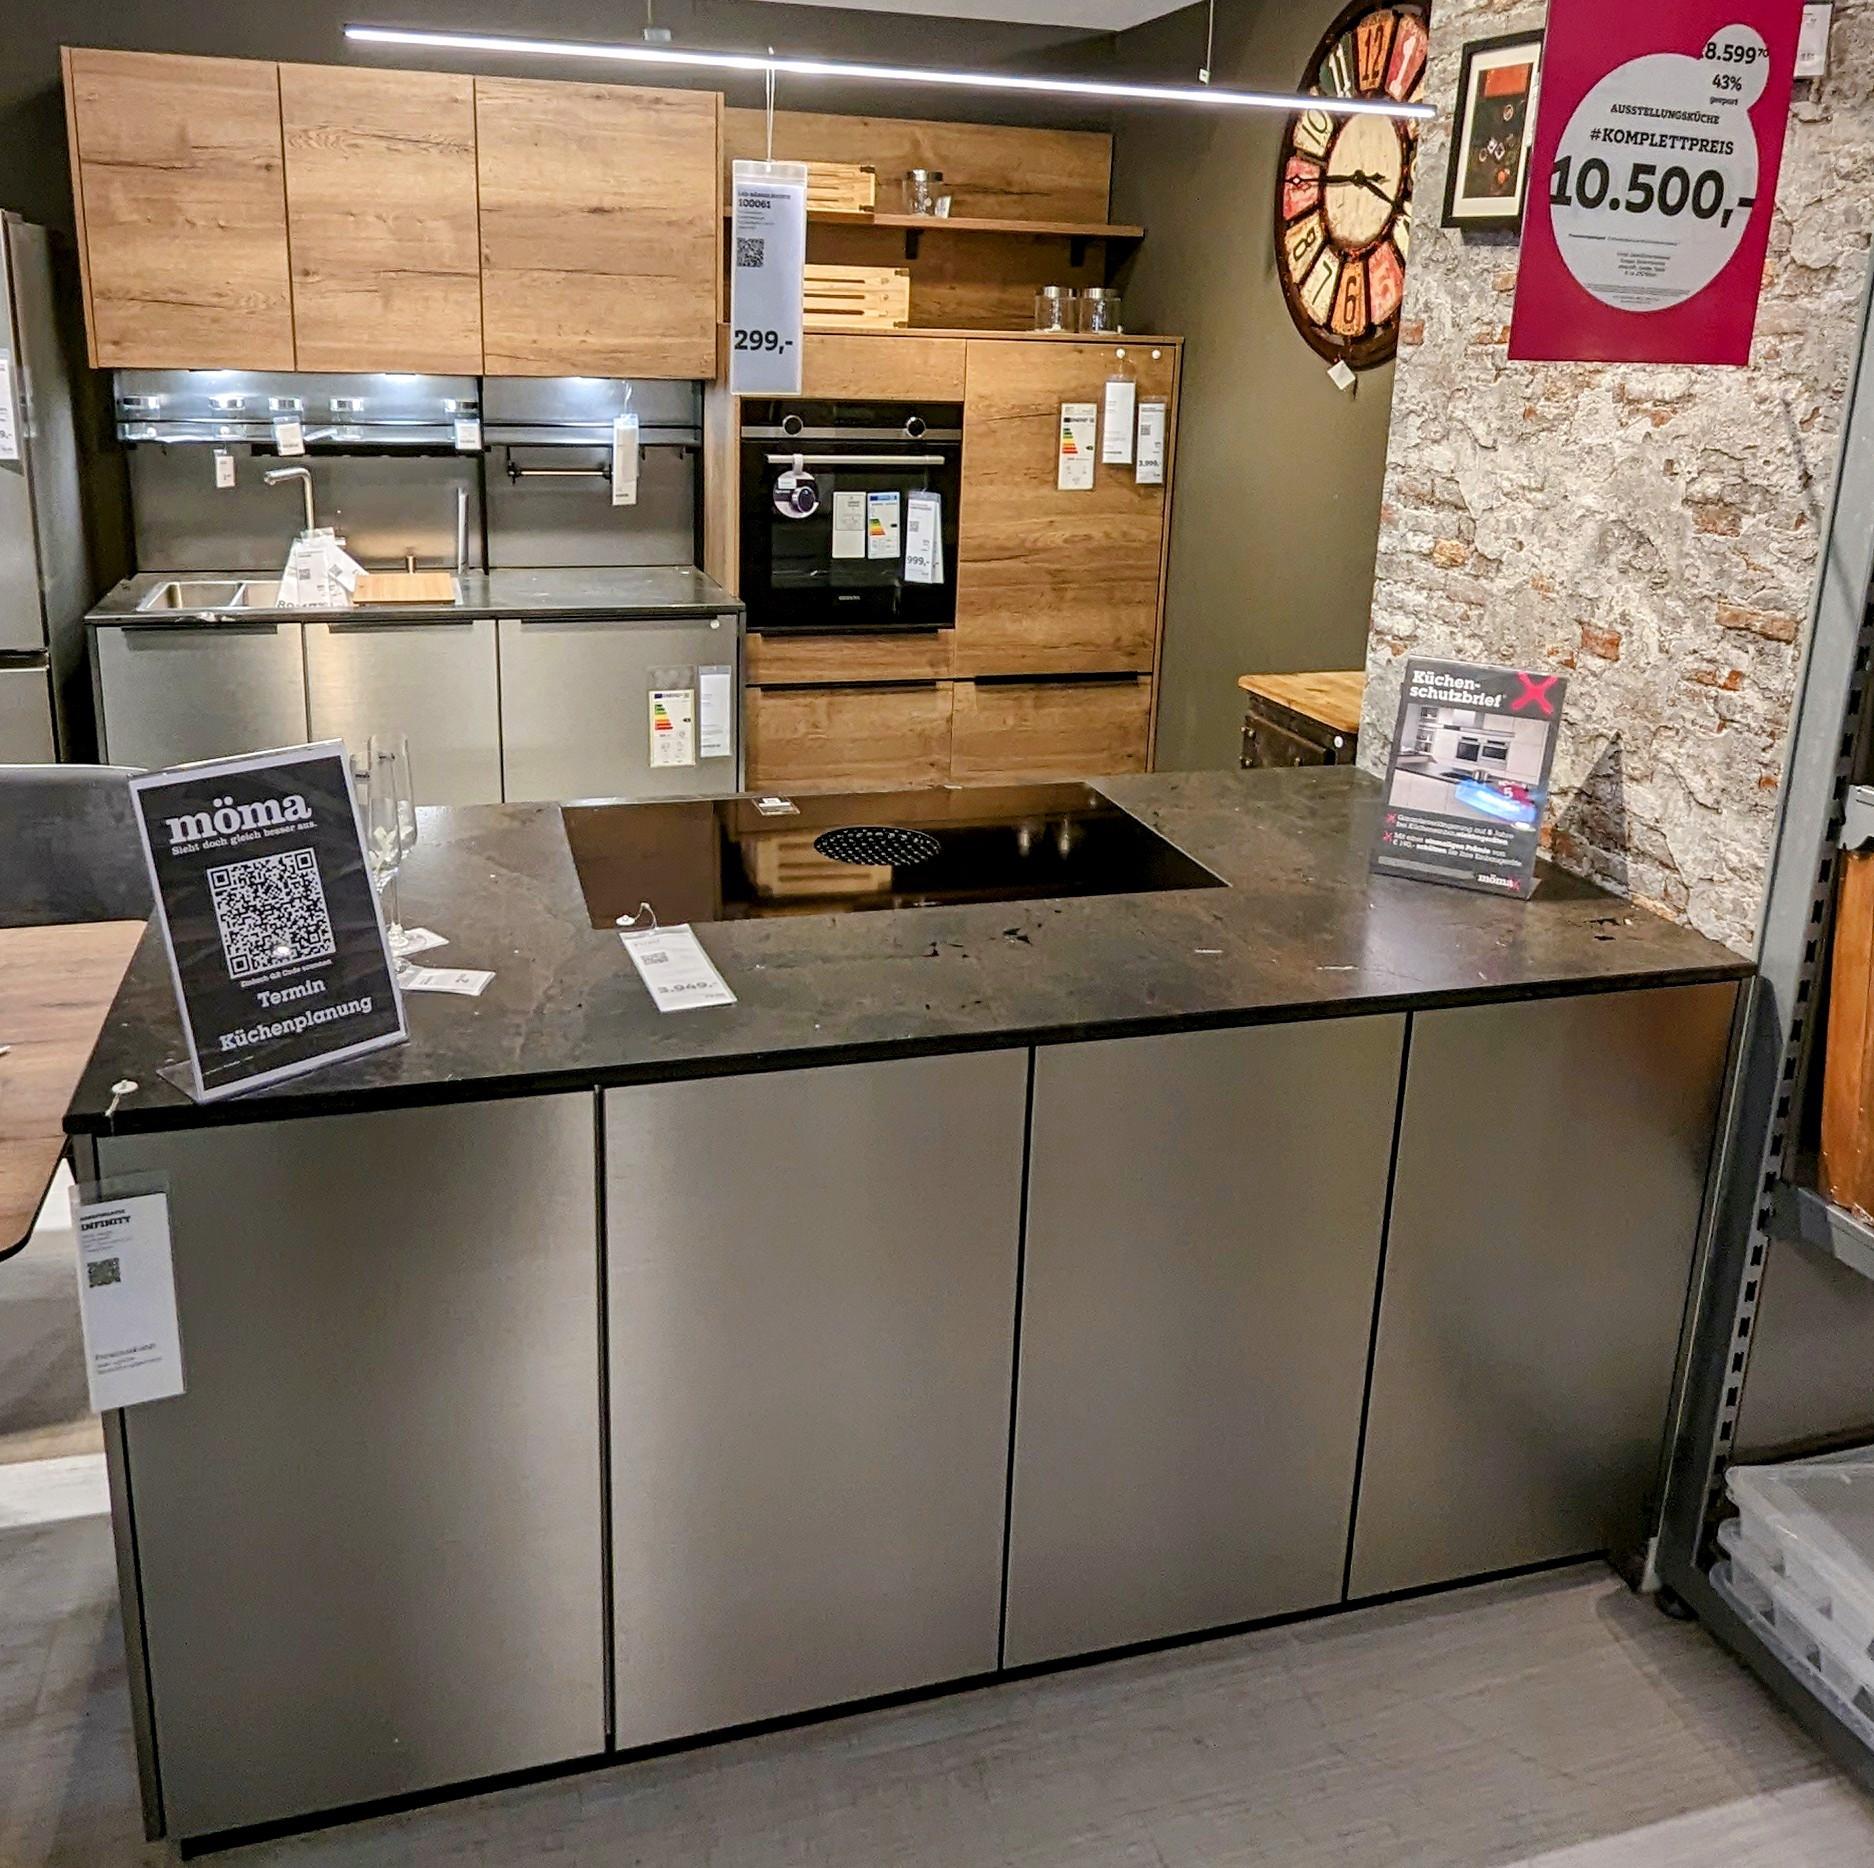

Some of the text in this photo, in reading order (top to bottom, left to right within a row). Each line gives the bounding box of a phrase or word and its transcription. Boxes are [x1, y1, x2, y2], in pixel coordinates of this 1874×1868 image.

[1712, 74, 1742, 91] 43%
[1611, 104, 1720, 125] AUSSTELLUNGSKÜCHE
[1590, 128, 1734, 155] #KOMPLETTPREIS
[1344, 276, 1357, 324] 6
[734, 330, 793, 354] 299,-
[1412, 670, 1481, 690] Küchen-
[165, 794, 313, 845] möma
[171, 843, 201, 856] Sieht
[203, 838, 228, 849] doch
[230, 831, 262, 846] gleich
[257, 979, 327, 1008] Termin
[219, 996, 373, 1051] Küchenplanung
